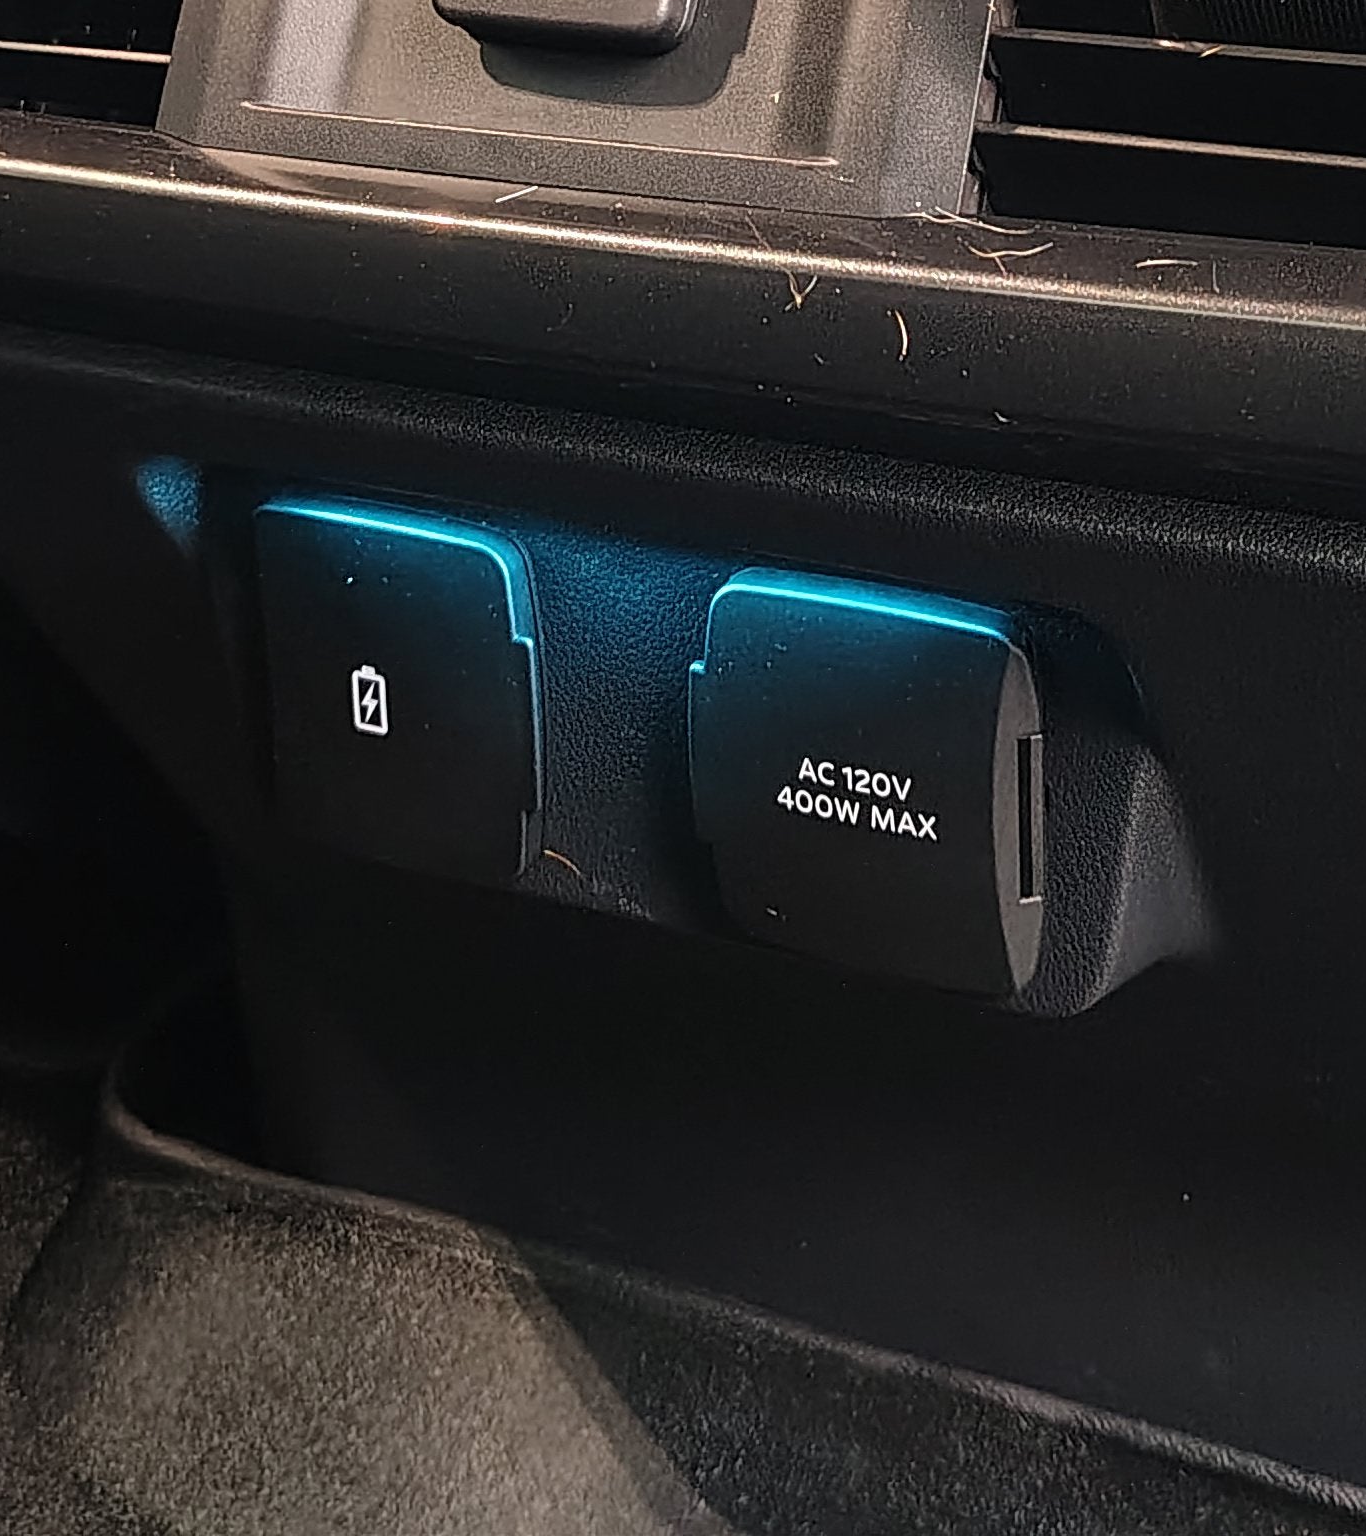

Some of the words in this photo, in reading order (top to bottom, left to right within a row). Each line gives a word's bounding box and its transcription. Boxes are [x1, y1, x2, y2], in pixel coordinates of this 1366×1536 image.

[798, 757, 835, 787] AC
[841, 766, 912, 802] 120V
[776, 785, 860, 825] 400W
[870, 804, 938, 841] MAX
